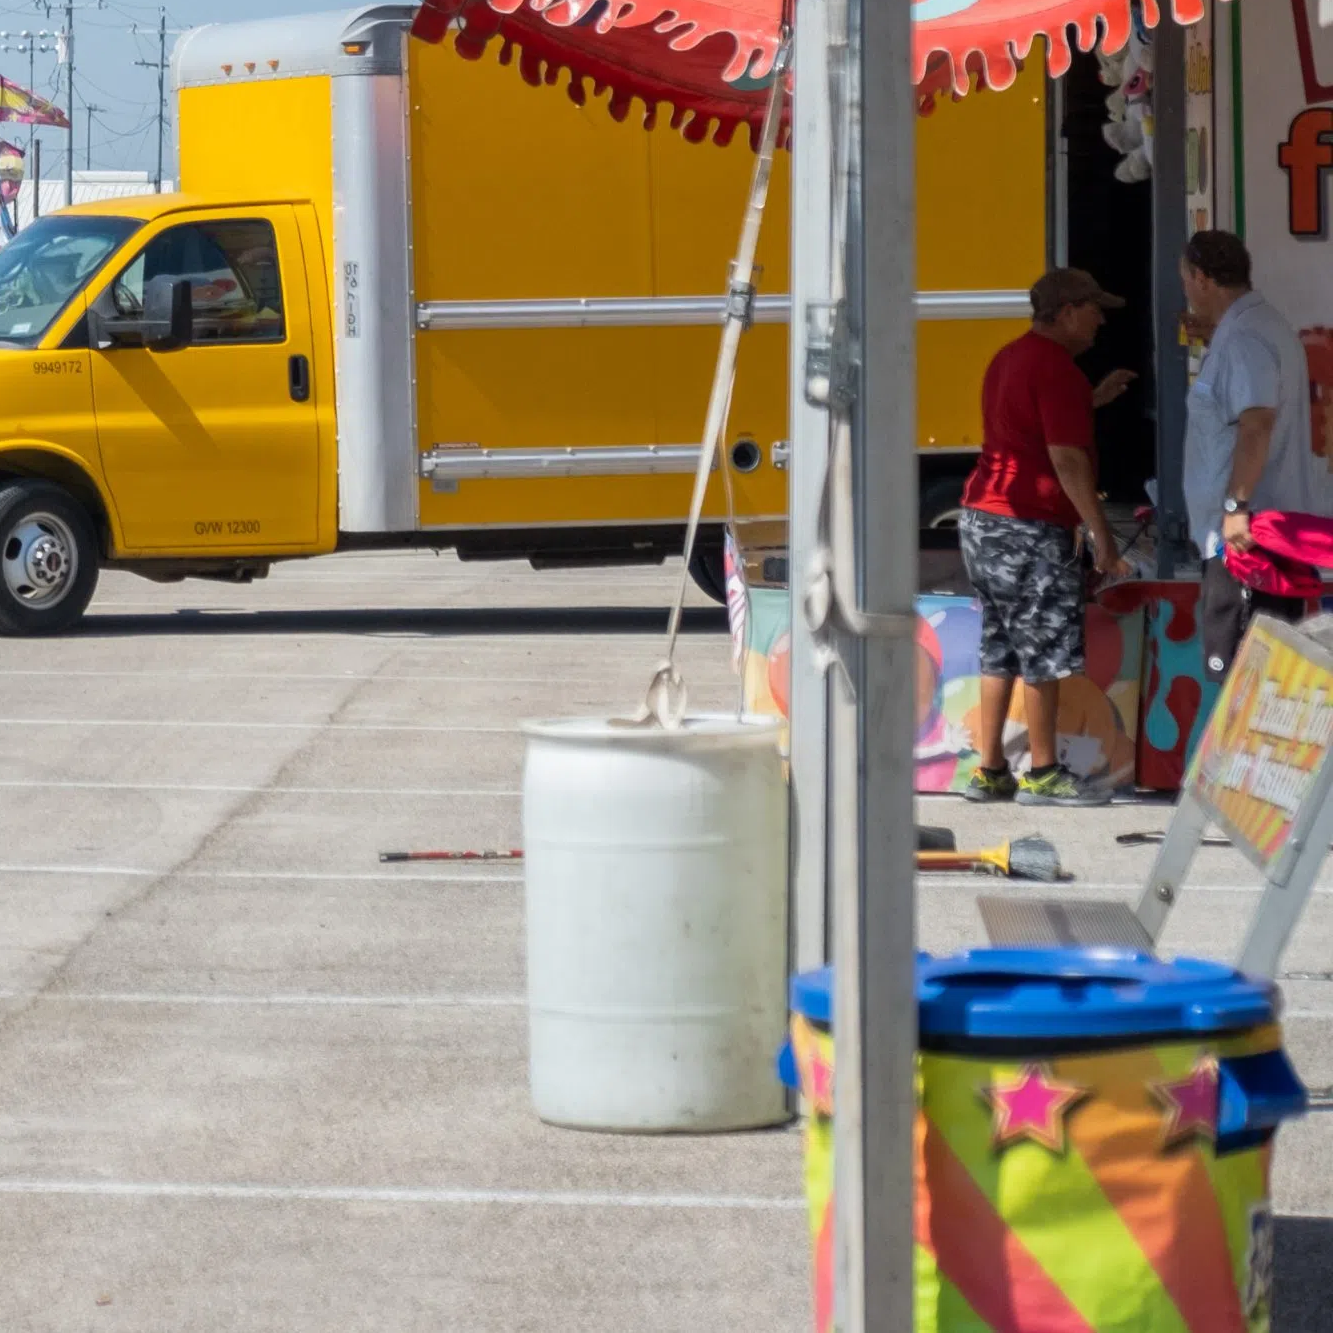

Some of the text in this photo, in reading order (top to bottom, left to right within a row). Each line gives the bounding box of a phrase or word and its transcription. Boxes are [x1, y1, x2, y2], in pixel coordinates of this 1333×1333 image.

[33, 360, 83, 375] 9949172
[194, 519, 262, 535] GVW 12300
